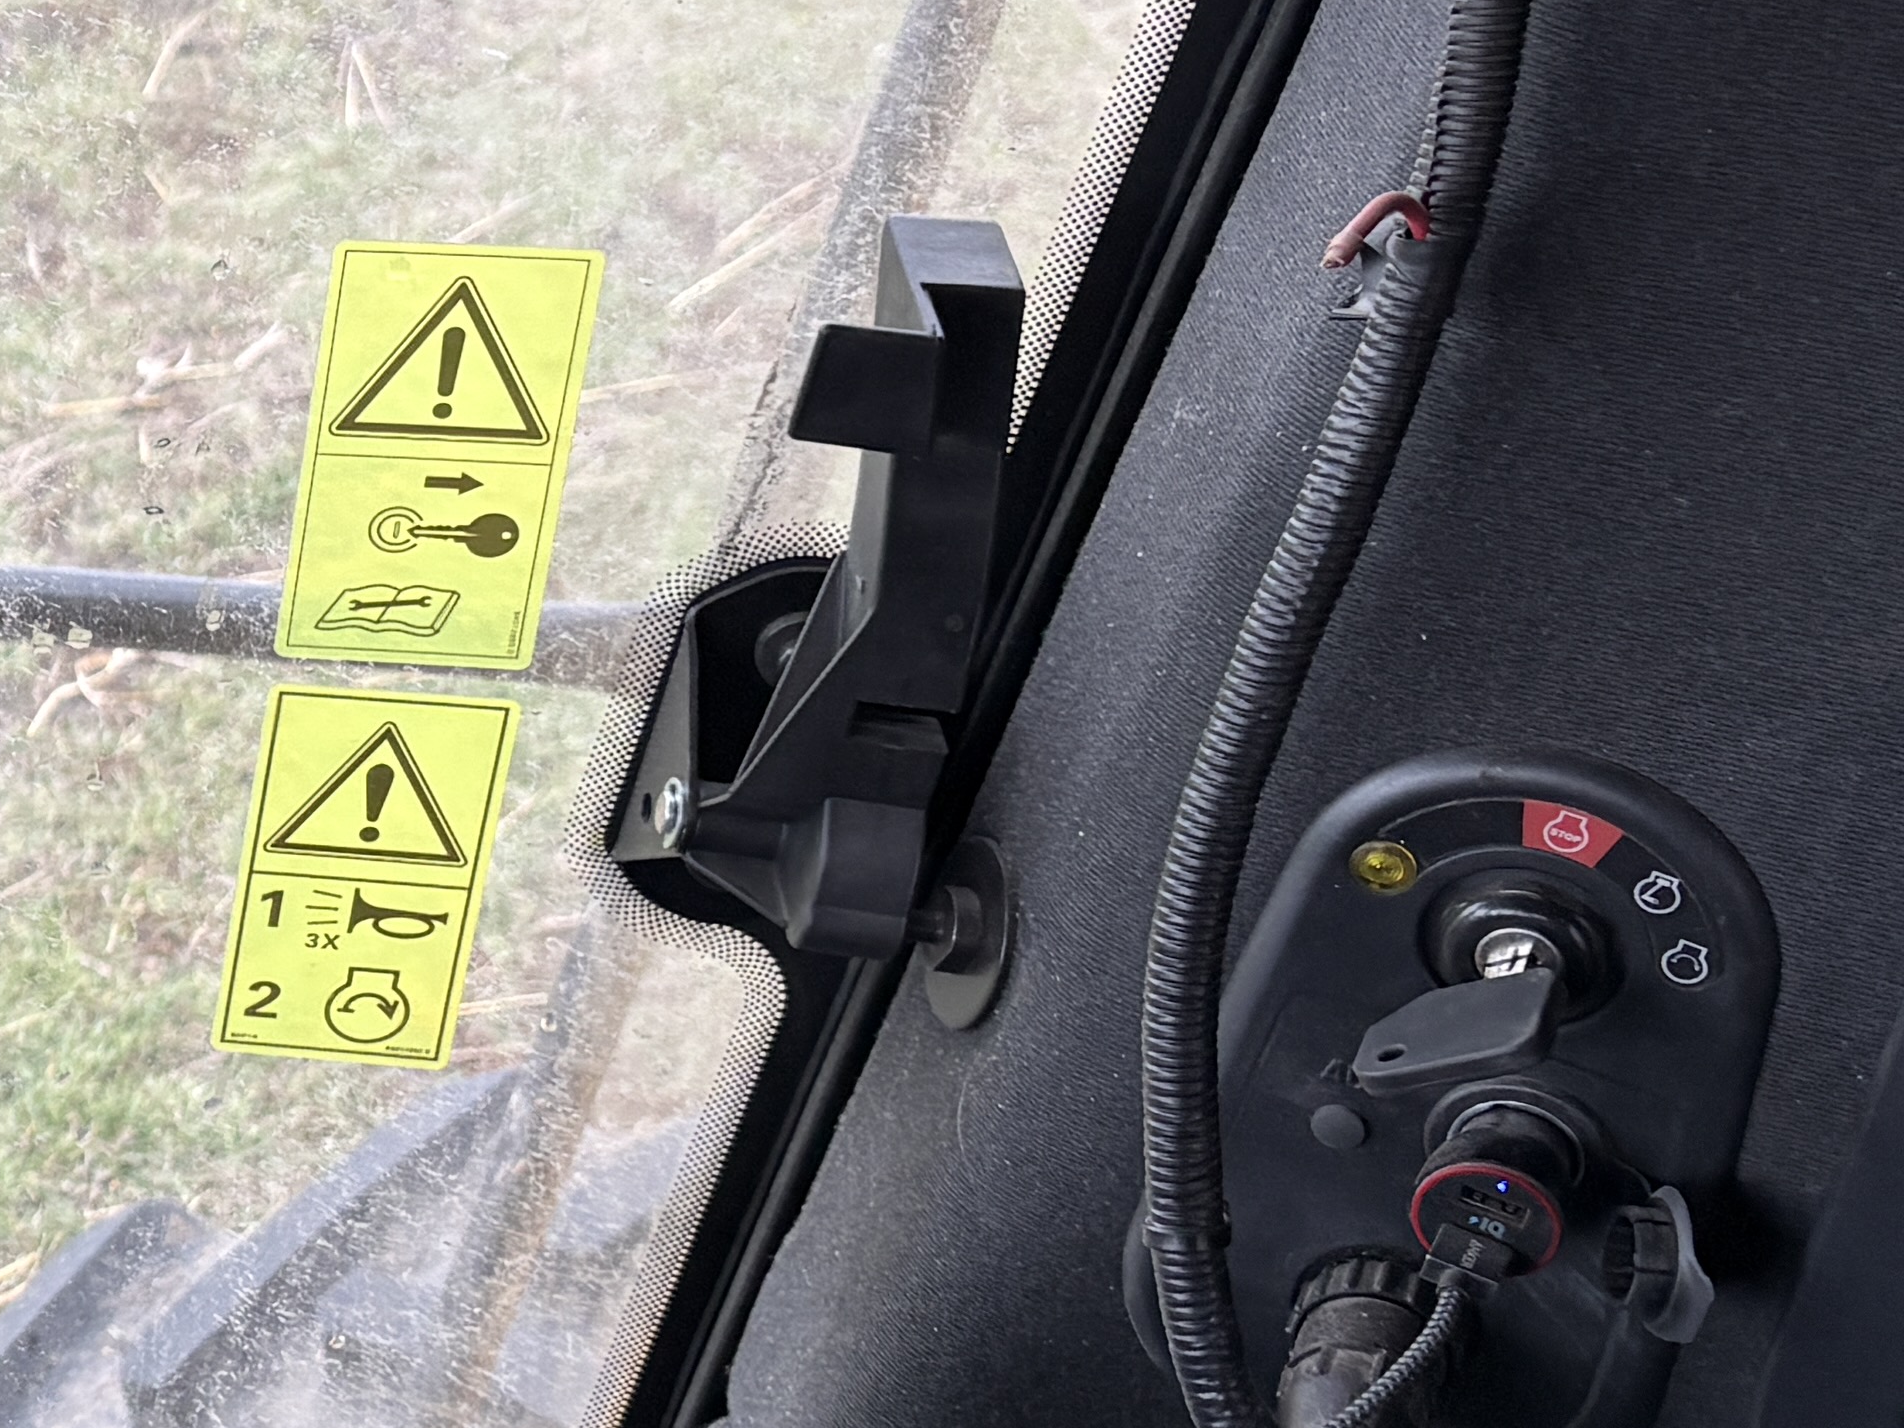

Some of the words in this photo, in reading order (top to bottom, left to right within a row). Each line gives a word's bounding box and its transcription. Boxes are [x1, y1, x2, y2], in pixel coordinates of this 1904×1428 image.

[1549, 827, 1582, 843] STOP
[260, 889, 284, 928] 1
[304, 933, 340, 951] 3X
[243, 980, 282, 1019] 2
